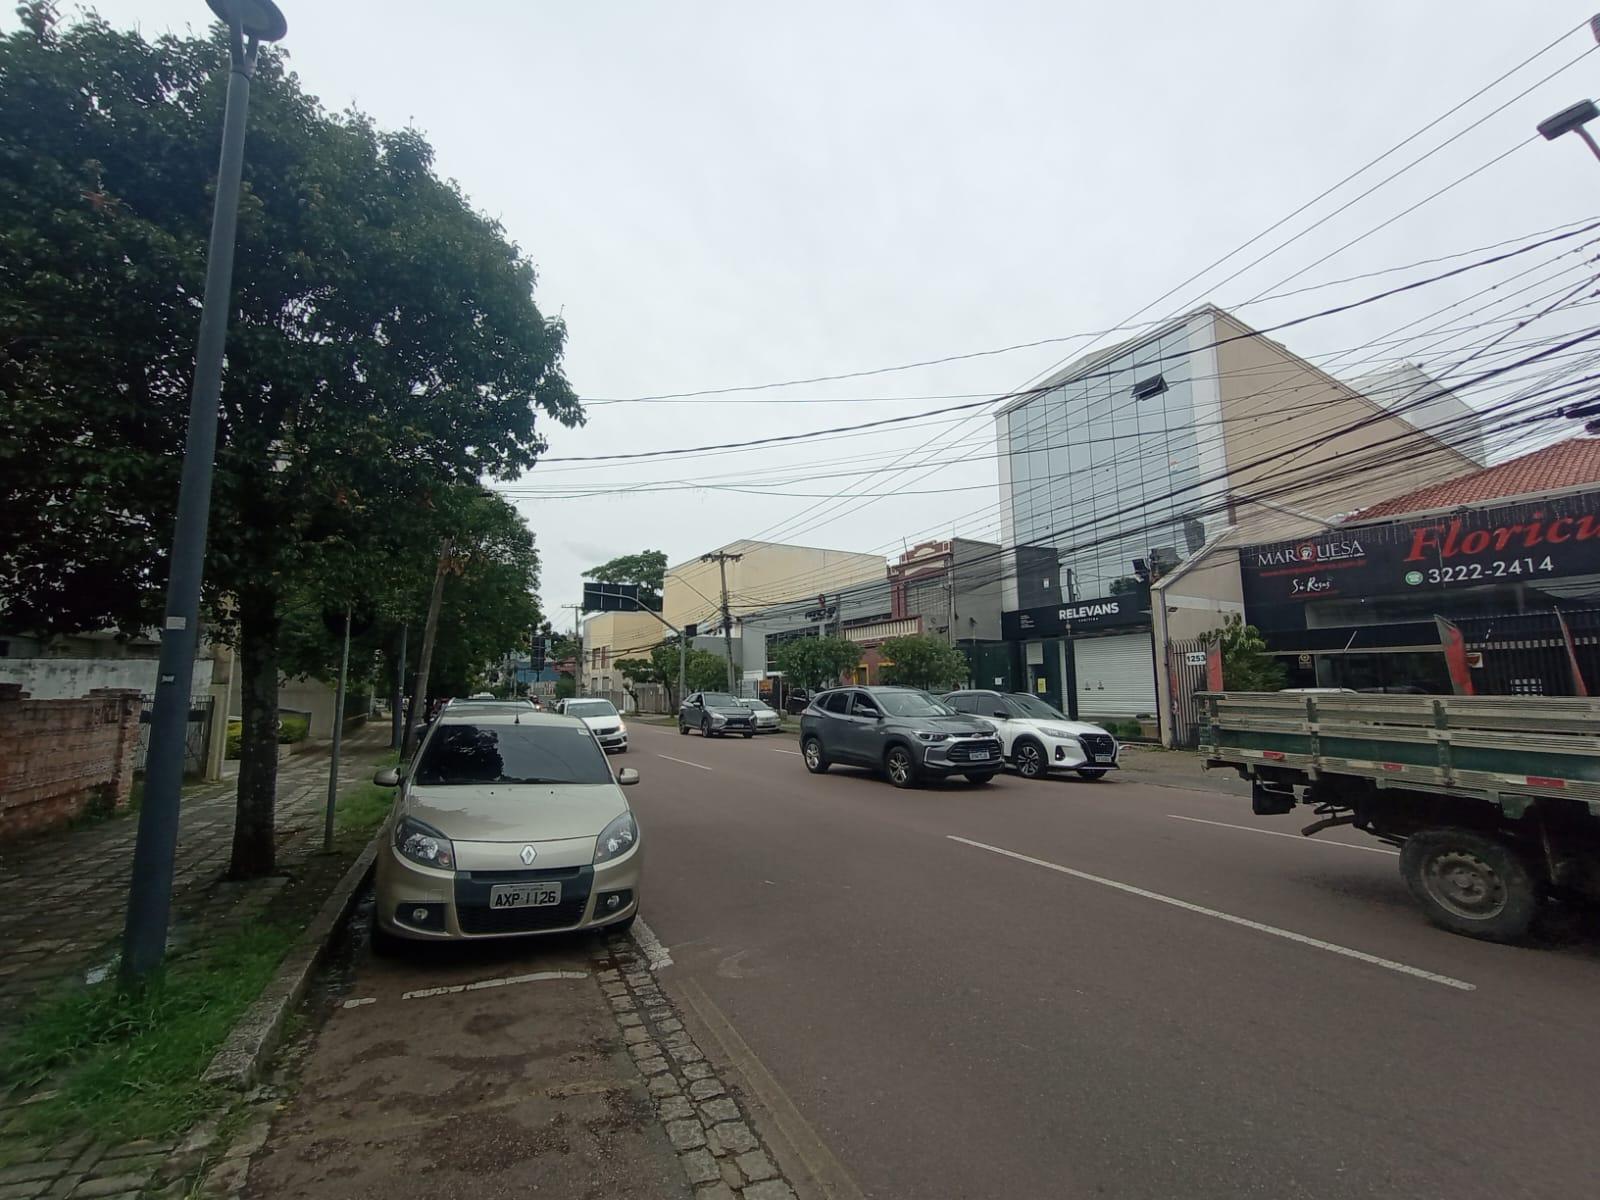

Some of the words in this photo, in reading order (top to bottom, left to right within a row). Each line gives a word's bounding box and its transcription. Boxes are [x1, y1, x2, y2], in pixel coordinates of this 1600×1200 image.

[1258, 540, 1363, 567] MARQUESA
[1428, 556, 1554, 584] 3222-2414
[1059, 603, 1119, 620] RELEVANS
[1187, 654, 1206, 663] 1253
